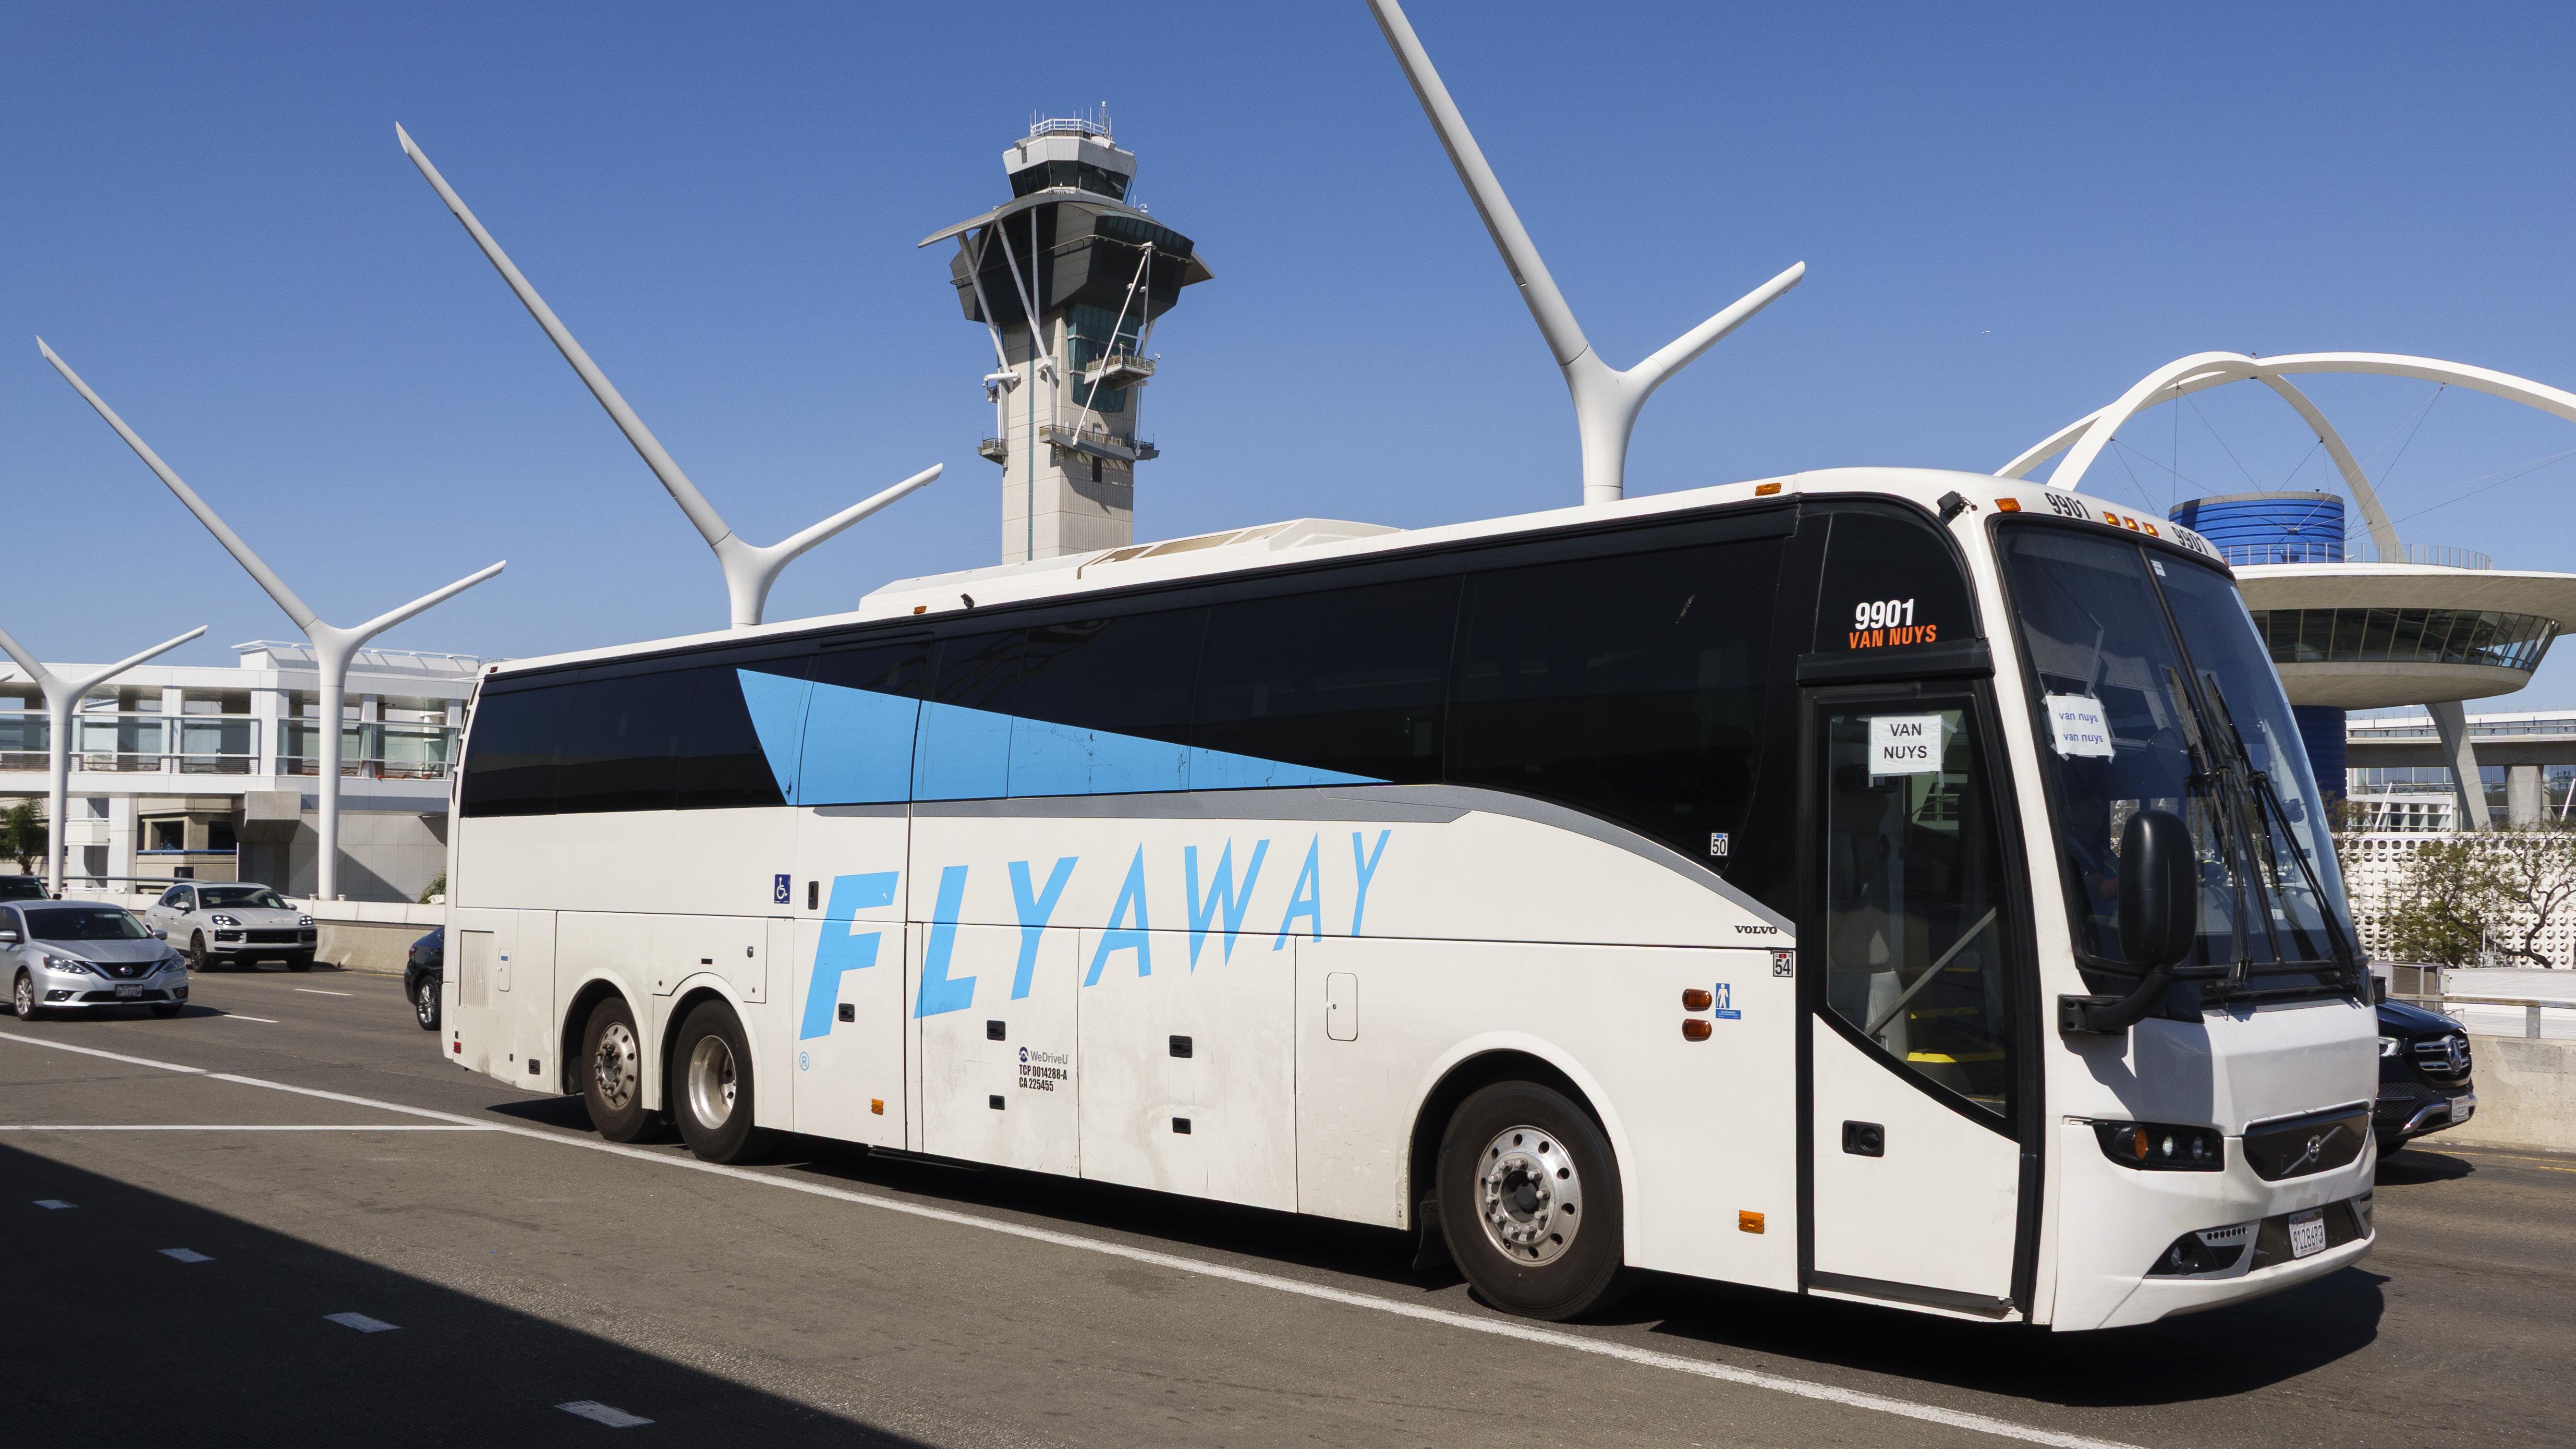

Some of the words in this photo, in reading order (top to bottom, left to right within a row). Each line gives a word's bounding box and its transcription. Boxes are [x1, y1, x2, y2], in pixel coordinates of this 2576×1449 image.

[2045, 492, 2091, 520] 9901
[2171, 526, 2209, 556] 9901
[1855, 598, 1914, 630] 9901
[1849, 629, 1884, 649] VAN
[1889, 624, 1937, 646] NUYS
[2078, 713, 2098, 724] nuys
[1890, 723, 1922, 736] VAN
[2081, 734, 2104, 744] nuys
[1884, 745, 1927, 759] NUYS
[1712, 839, 1727, 855] 50
[1734, 925, 1778, 935] VOLVO
[1775, 959, 1791, 975] 54
[1030, 1050, 1068, 1065] WeDriveU
[1019, 1064, 1031, 1076] TCP
[1032, 1066, 1067, 1080] 0014288-A
[1019, 1077, 1028, 1089] CA
[1029, 1078, 1053, 1092] 225455
[2293, 1224, 2323, 1251] 91286P3
